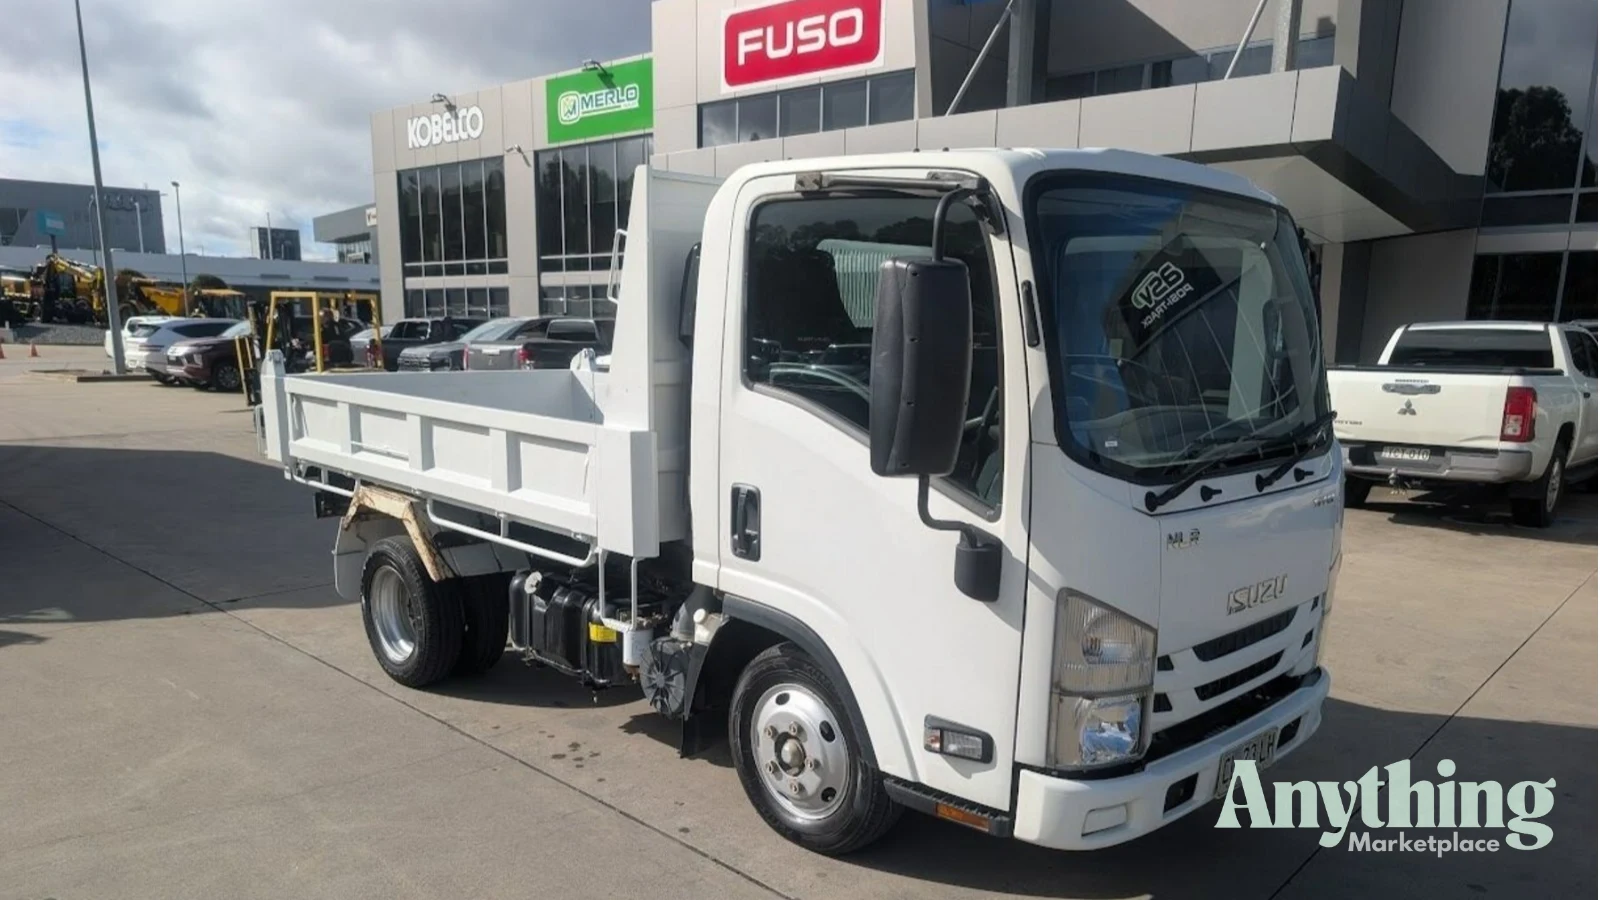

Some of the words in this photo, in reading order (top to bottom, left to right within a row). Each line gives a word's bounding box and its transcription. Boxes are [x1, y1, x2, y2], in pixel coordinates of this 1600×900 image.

[738, 7, 864, 66] FUSO
[581, 87, 639, 110] MERLO
[407, 105, 484, 149] KOBELCO
[1226, 573, 1288, 616] ISUZU
